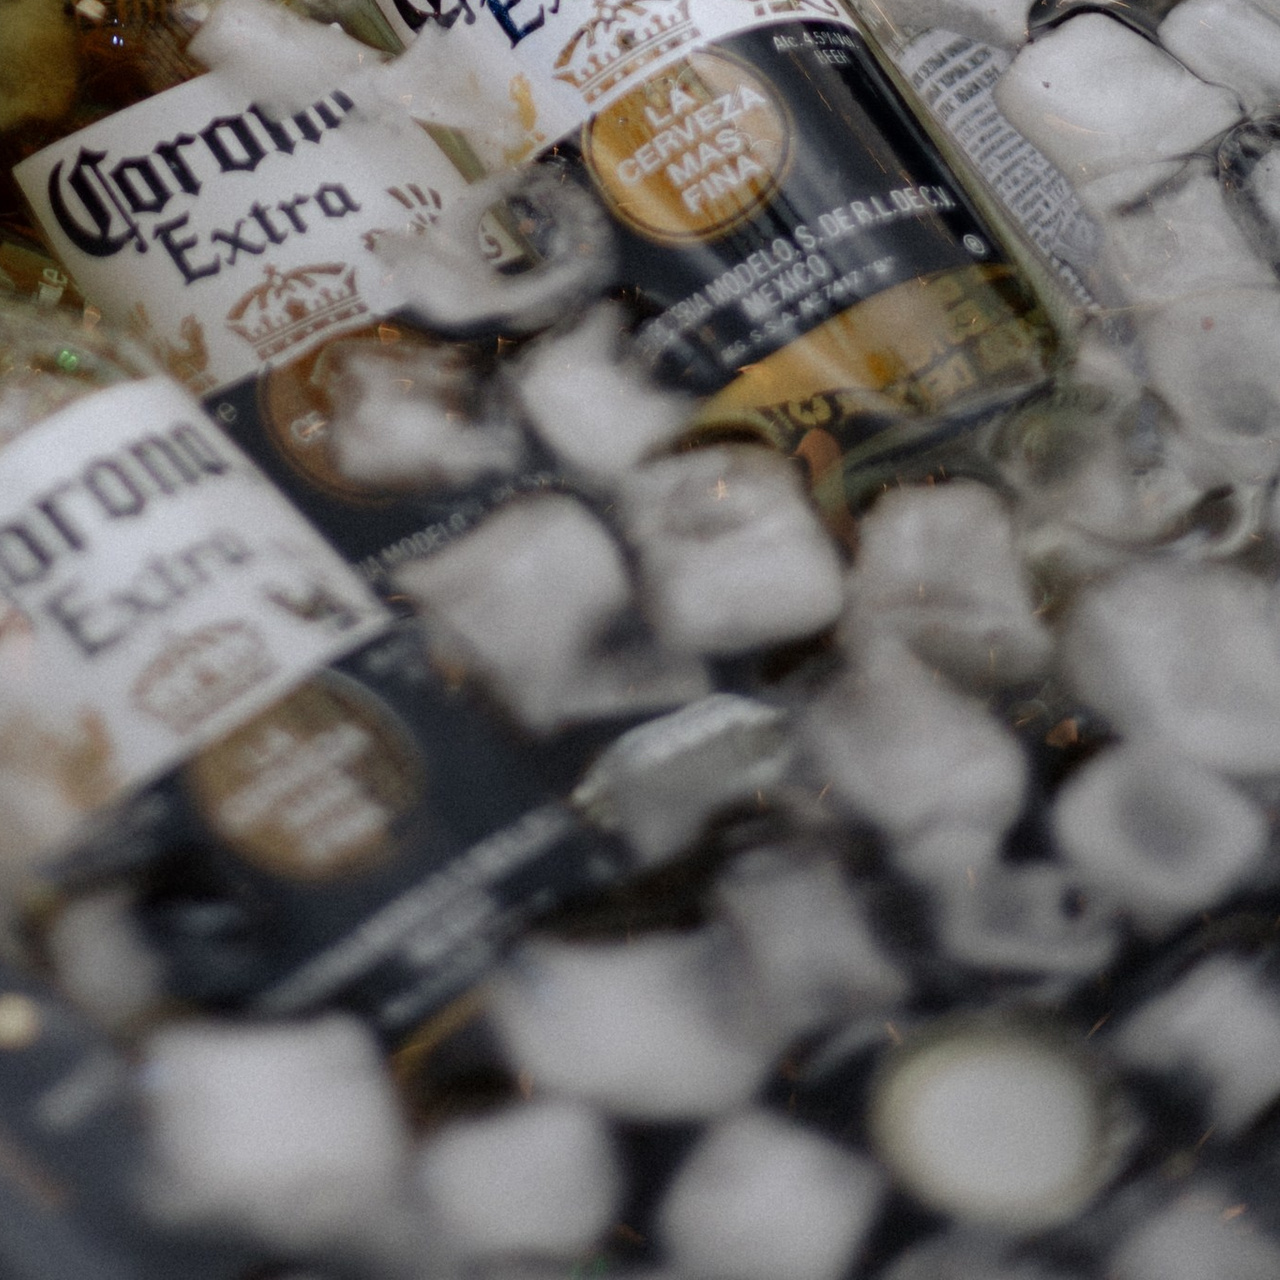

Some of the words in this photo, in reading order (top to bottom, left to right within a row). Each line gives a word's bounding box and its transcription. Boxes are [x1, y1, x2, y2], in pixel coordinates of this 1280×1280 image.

[616, 85, 768, 186] CERVEZA
[644, 85, 697, 128] LA
[665, 128, 743, 187] MAS
[681, 154, 765, 216] FINA
[153, 182, 362, 286] Extra
[741, 254, 832, 322] MEXICO
[43, 525, 255, 657] Extra
